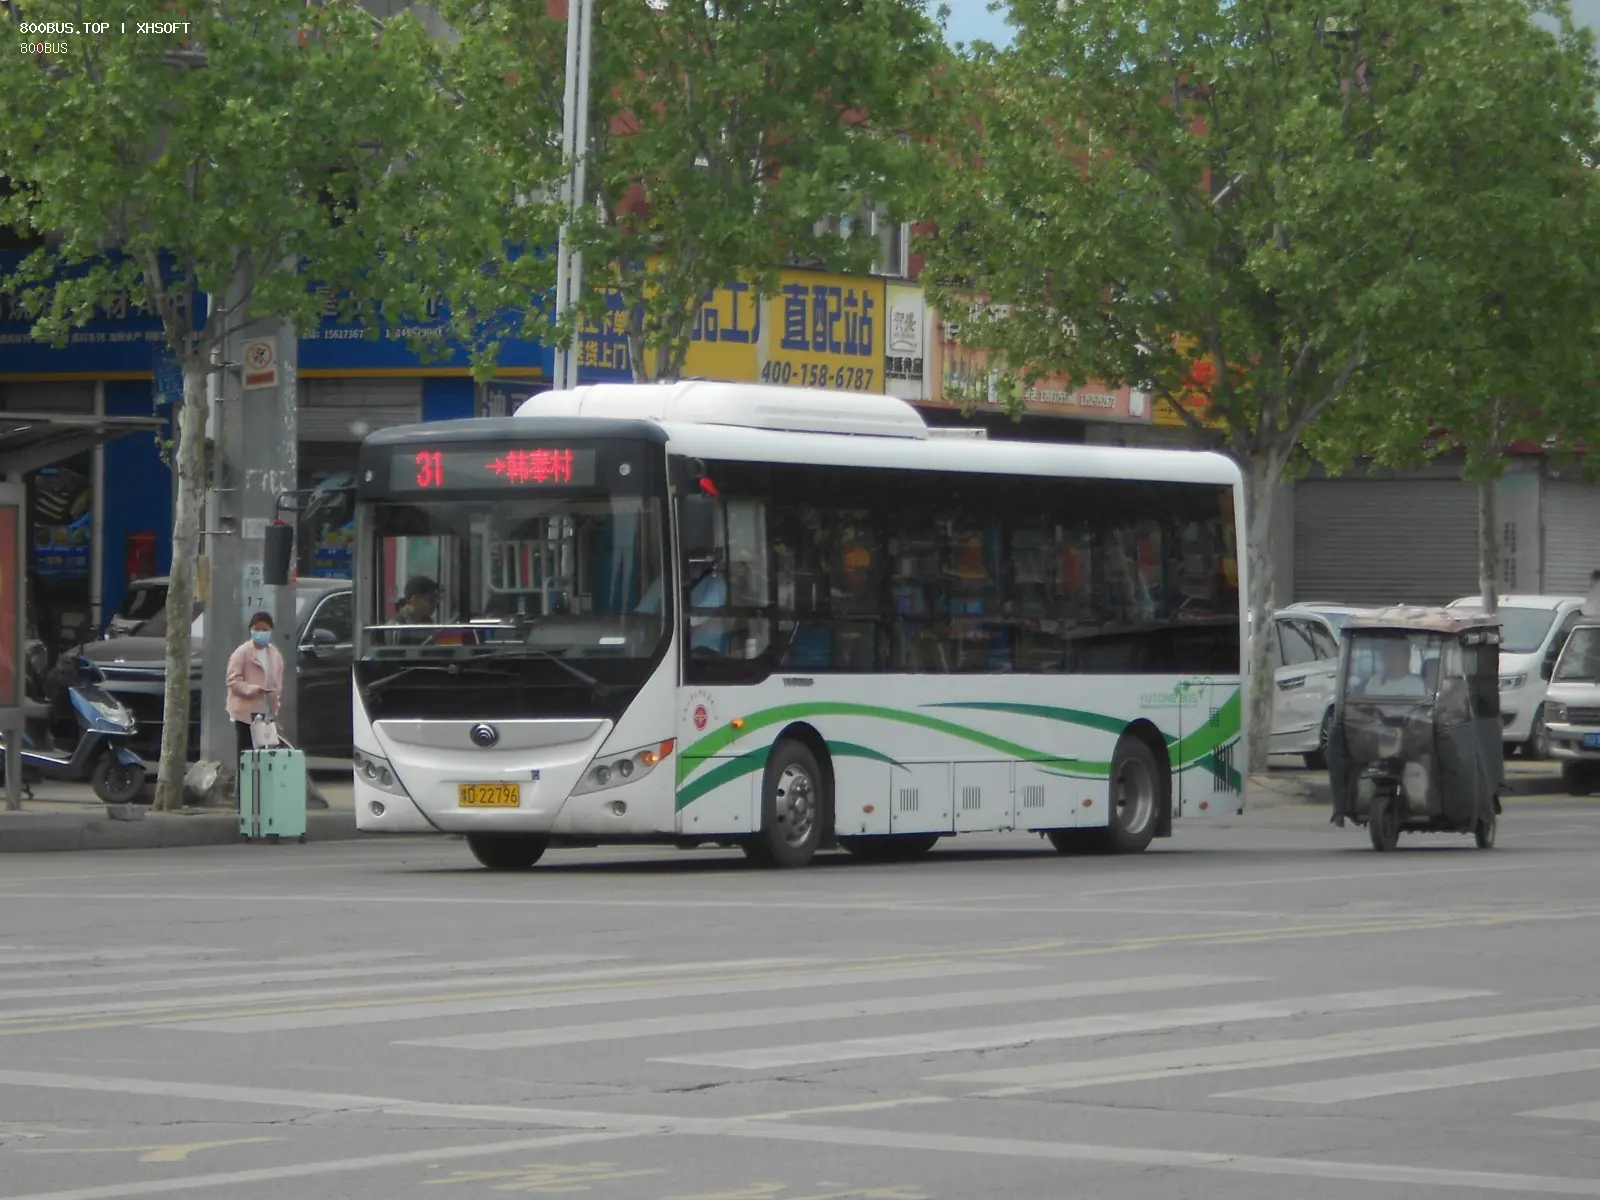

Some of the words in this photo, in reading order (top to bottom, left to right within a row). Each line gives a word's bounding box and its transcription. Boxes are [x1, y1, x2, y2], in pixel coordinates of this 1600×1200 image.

[781, 283, 874, 356] 直配站
[762, 361, 874, 390] 400-158-6787
[415, 449, 443, 487] 31
